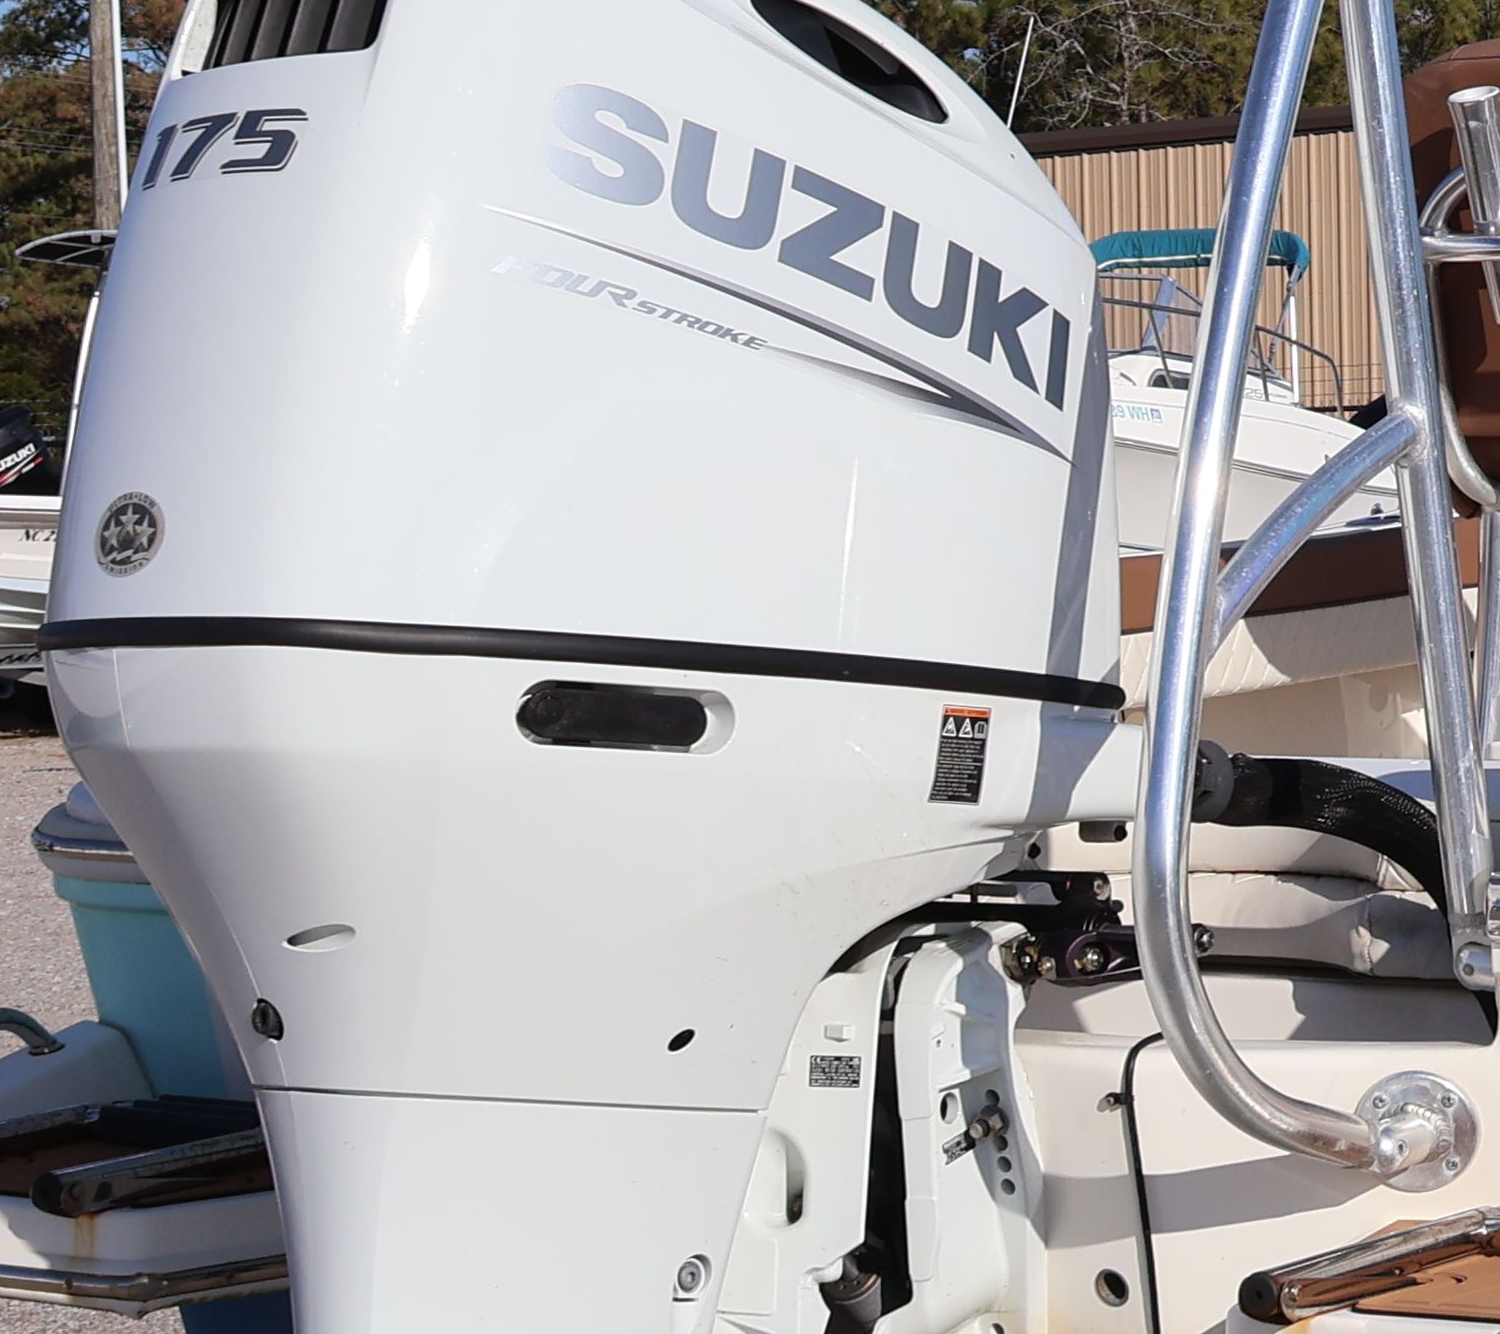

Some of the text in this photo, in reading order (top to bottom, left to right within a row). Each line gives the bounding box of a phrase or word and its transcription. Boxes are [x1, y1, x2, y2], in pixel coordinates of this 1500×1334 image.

[141, 107, 310, 192] 175
[545, 83, 1071, 412] SUZUKI
[491, 255, 769, 351] FOUR STROKE
